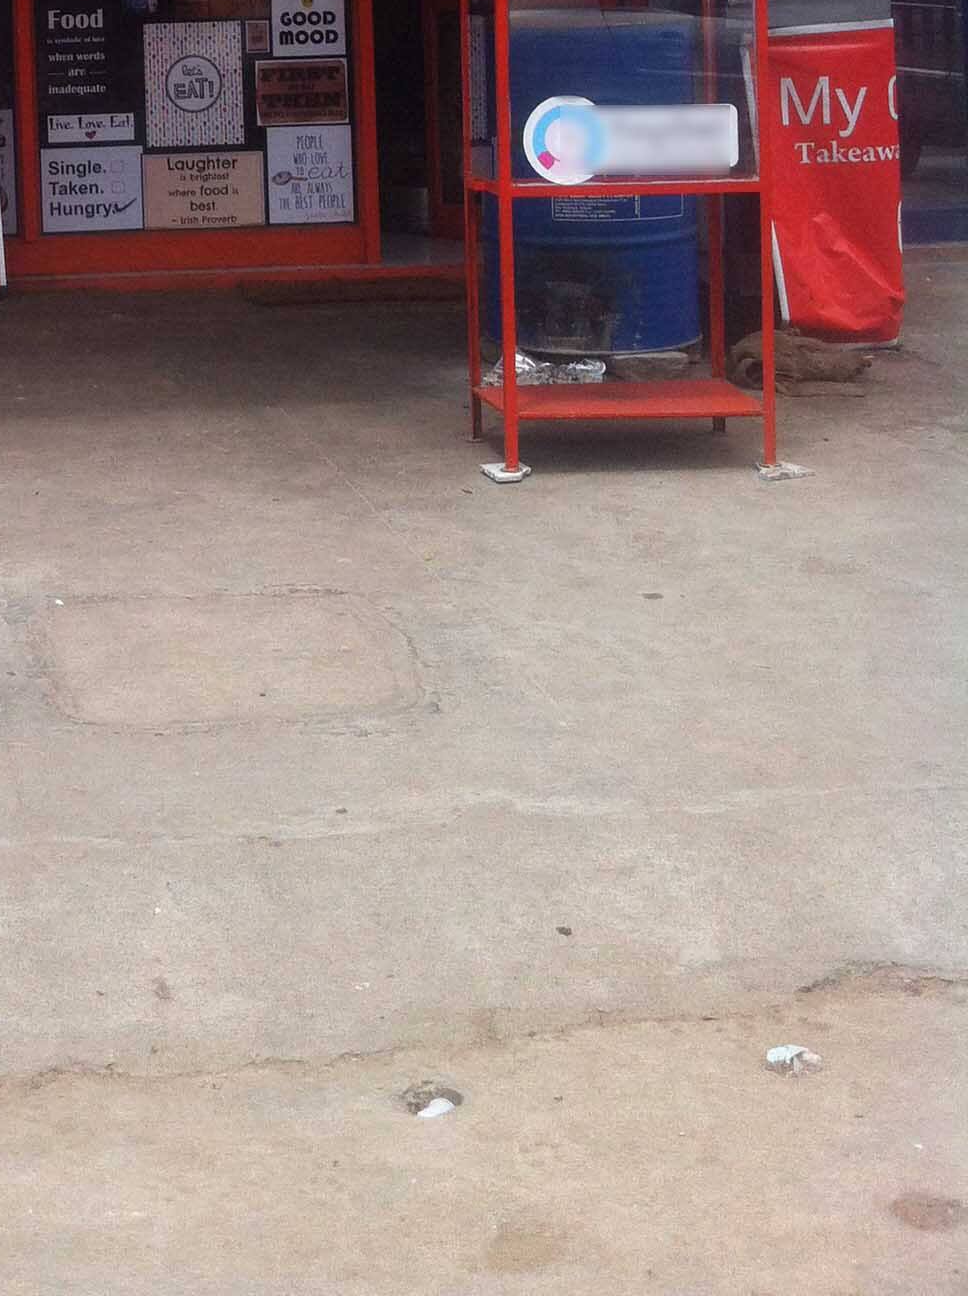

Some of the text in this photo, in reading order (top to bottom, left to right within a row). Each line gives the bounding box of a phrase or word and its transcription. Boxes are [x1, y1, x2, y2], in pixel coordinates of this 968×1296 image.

[47, 7, 104, 30] Food
[279, 11, 336, 27] GOOD
[278, 29, 339, 46] MOOD
[47, 50, 106, 63] when words
[47, 83, 107, 96] inadequate
[173, 77, 214, 100] EAT!
[779, 75, 869, 138] My
[295, 134, 323, 151] PEOPLE
[47, 159, 107, 179] Single.
[166, 156, 239, 173] Laughter
[189, 171, 230, 183] brightest
[48, 180, 105, 197] Taken.
[167, 188, 197, 198] where
[200, 184, 230, 197] food
[294, 194, 314, 210] BEST
[318, 193, 347, 210] PEOPLE
[179, 215, 200, 225] Irish
[201, 214, 238, 225] Proverb
